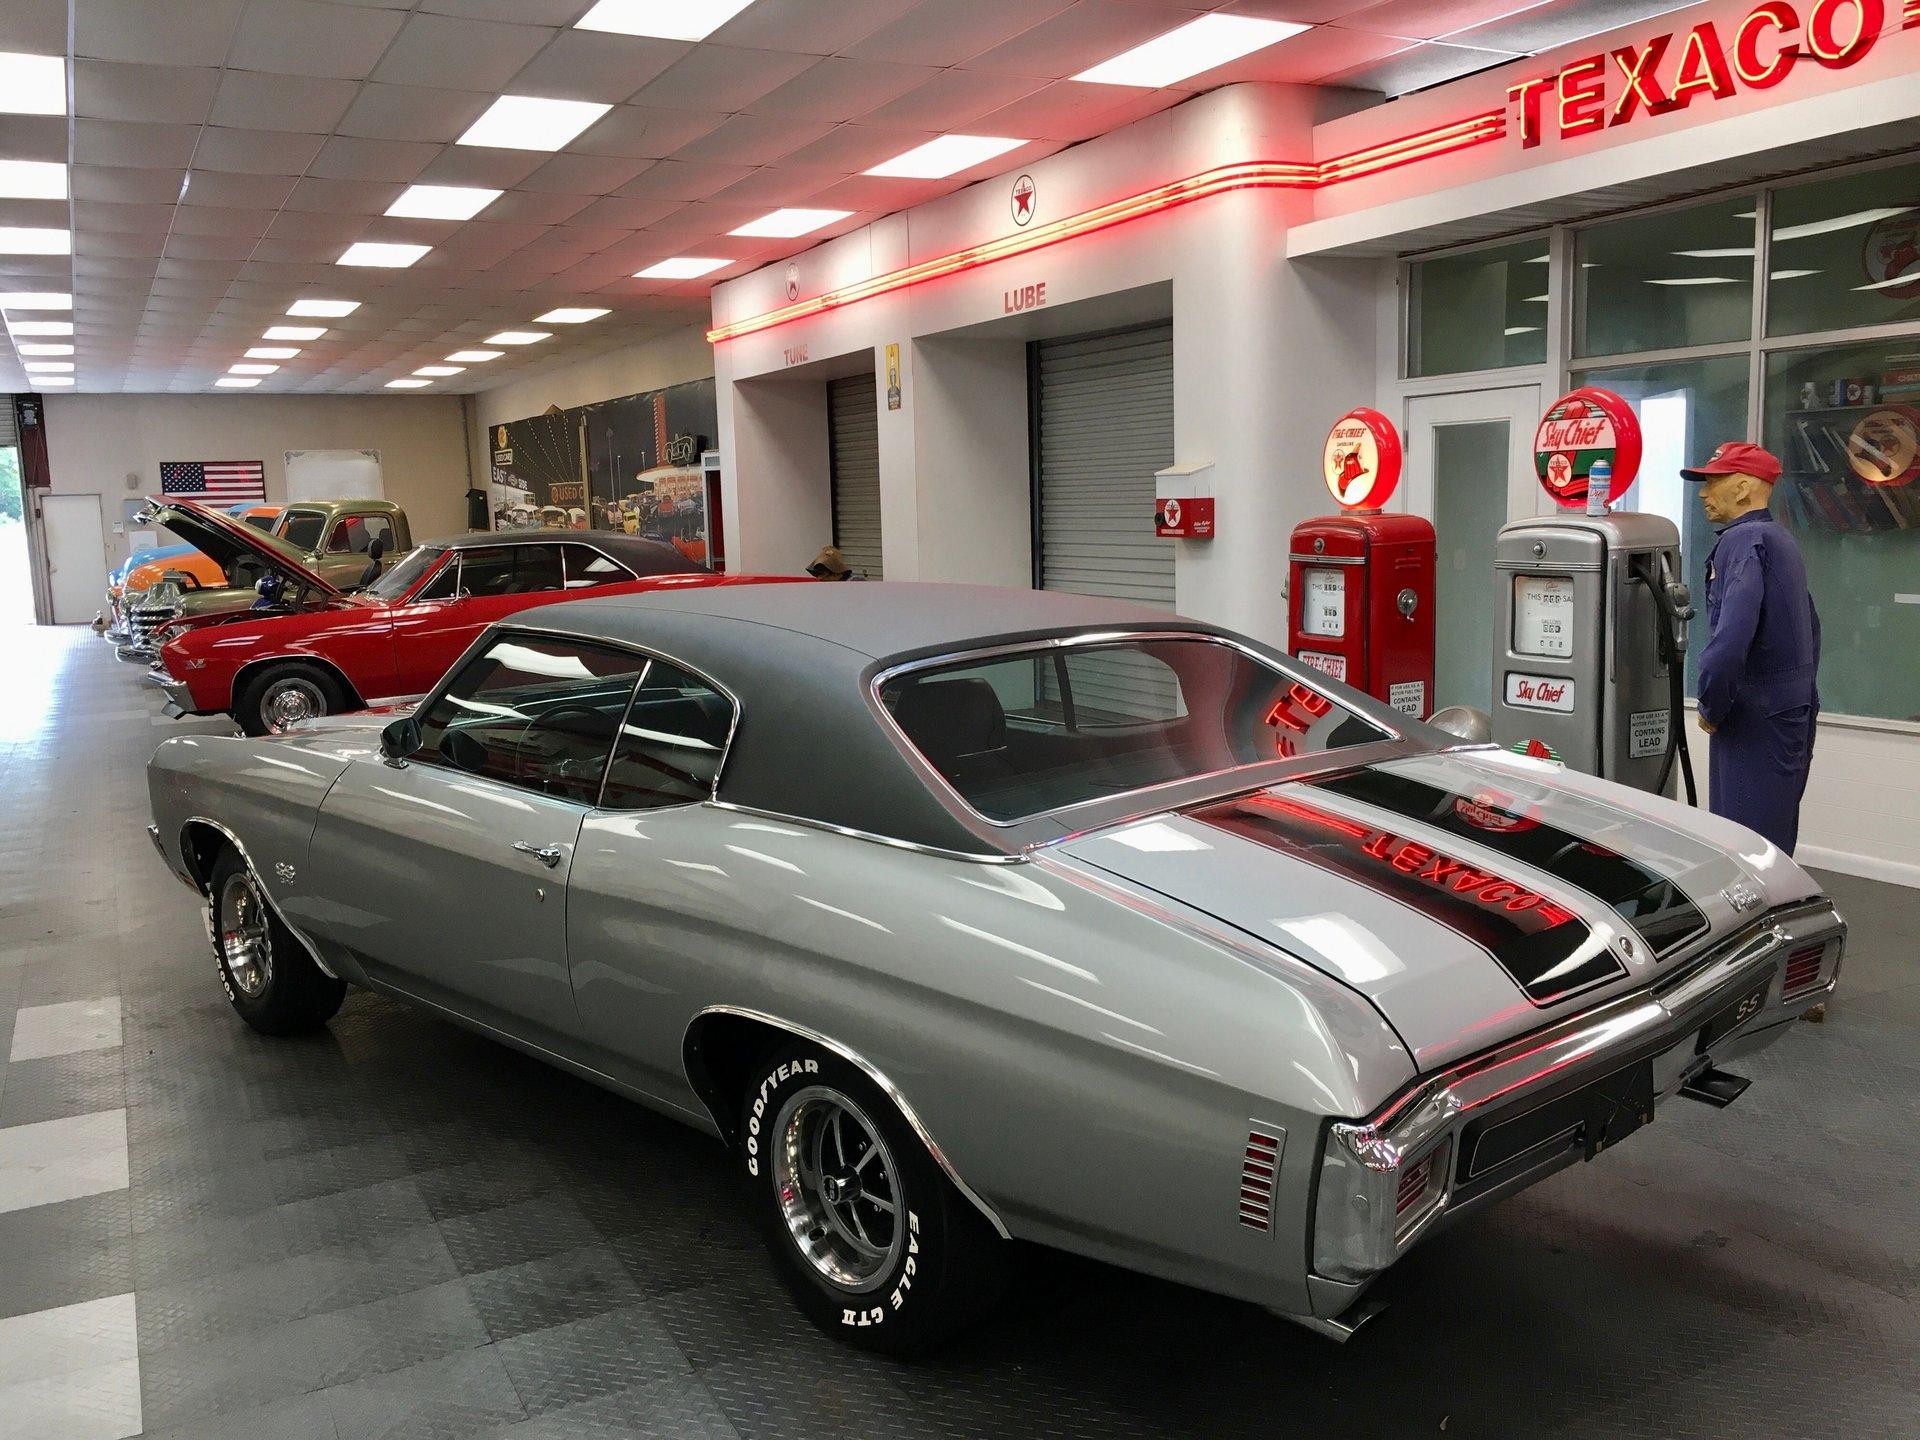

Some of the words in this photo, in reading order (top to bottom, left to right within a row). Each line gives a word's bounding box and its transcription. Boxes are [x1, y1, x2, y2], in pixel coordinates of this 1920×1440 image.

[1506, 0, 1884, 149] TEXACO
[1004, 282, 1046, 314] LUBE
[784, 344, 809, 366] TUNE
[1543, 421, 1565, 450] Sky
[1564, 419, 1606, 446] Chief
[560, 485, 577, 501] USED
[1526, 593, 1541, 601] THIS
[1393, 695, 1421, 704] CONTAINS
[1516, 680, 1535, 702] Sky
[1536, 682, 1565, 703] Chief
[1634, 726, 1666, 737] CONTAINS
[1638, 737, 1661, 748] LEAD
[1736, 993, 1760, 1020] SS
[747, 1059, 819, 1176] GOODYEAR
[891, 1210, 920, 1310] EAGLE
